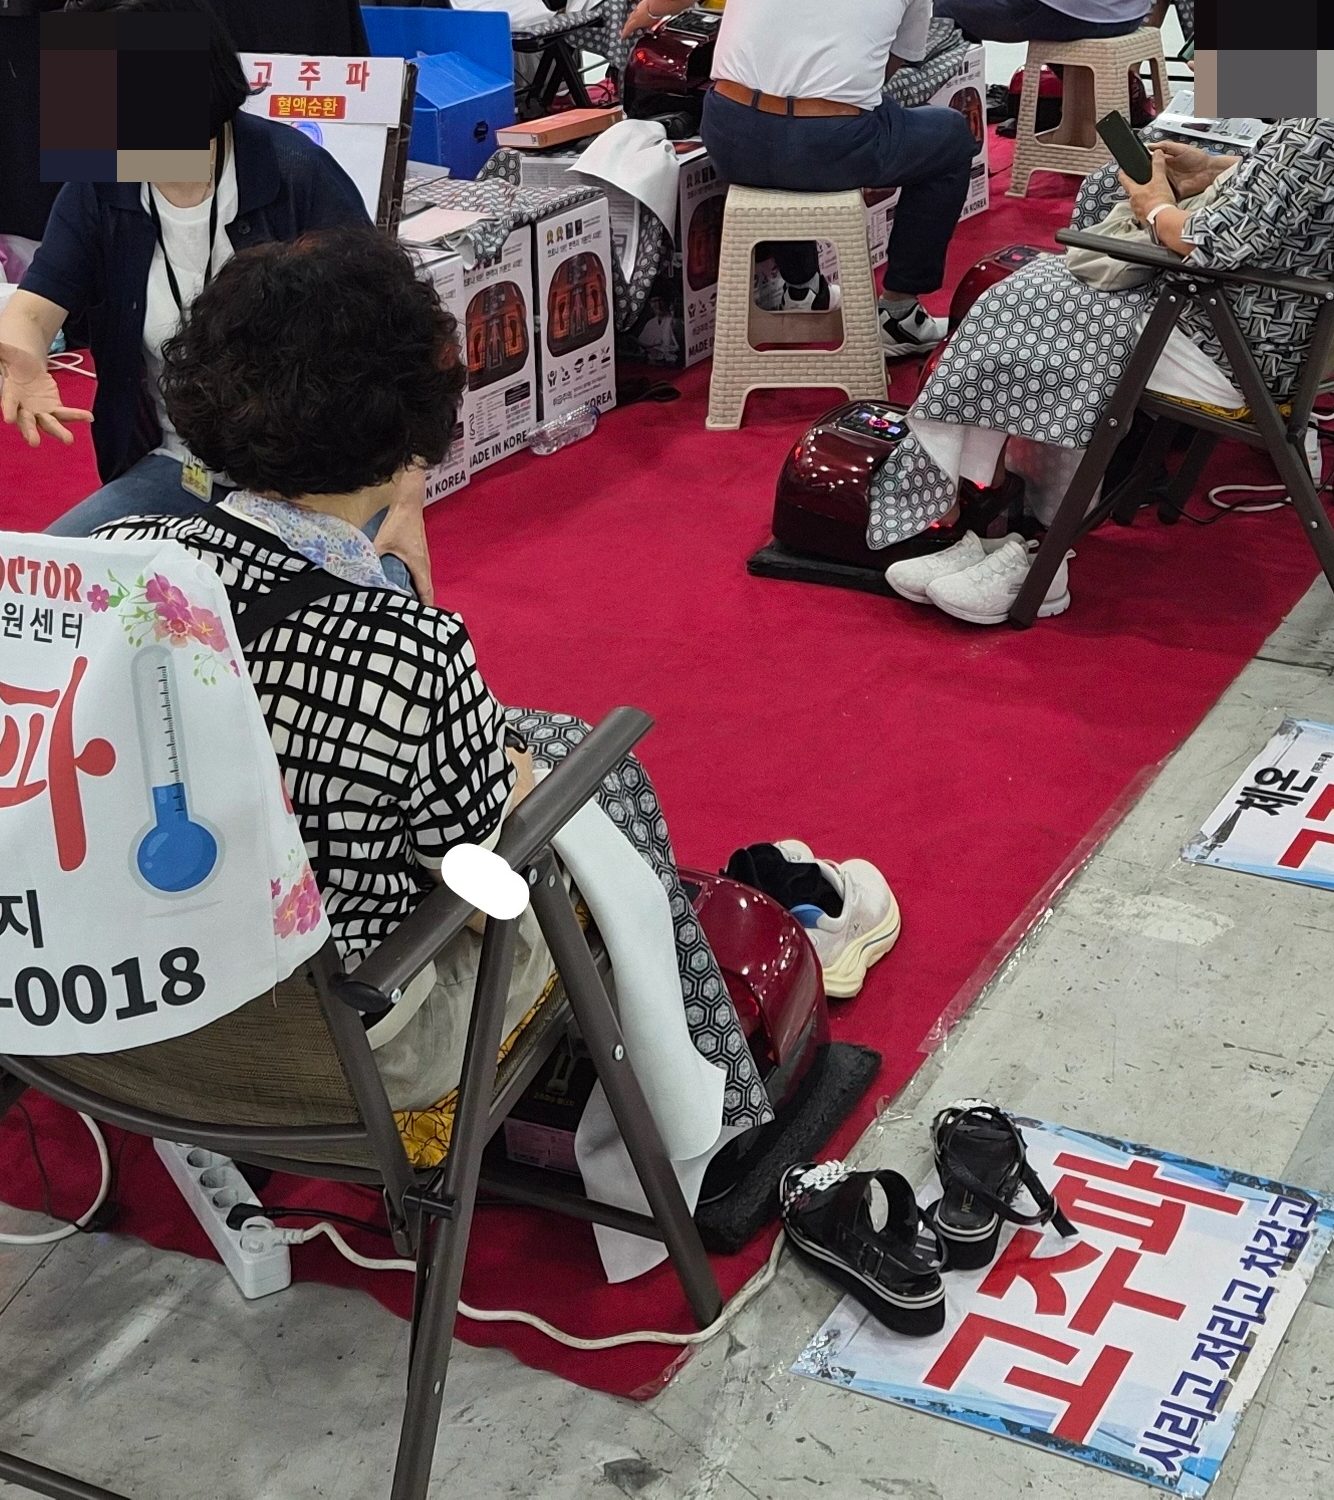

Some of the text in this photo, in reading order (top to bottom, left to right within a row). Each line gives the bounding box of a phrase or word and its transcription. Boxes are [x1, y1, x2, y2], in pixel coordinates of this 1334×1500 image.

[277, 95, 341, 118] 혈액순환
[492, 443, 501, 456] IN
[435, 470, 466, 495] KOREA
[1234, 766, 1319, 817] 체온
[921, 1151, 1246, 1445] 고주파
[1137, 1370, 1230, 1475] 시리고
[1191, 1277, 1276, 1372] 저리고
